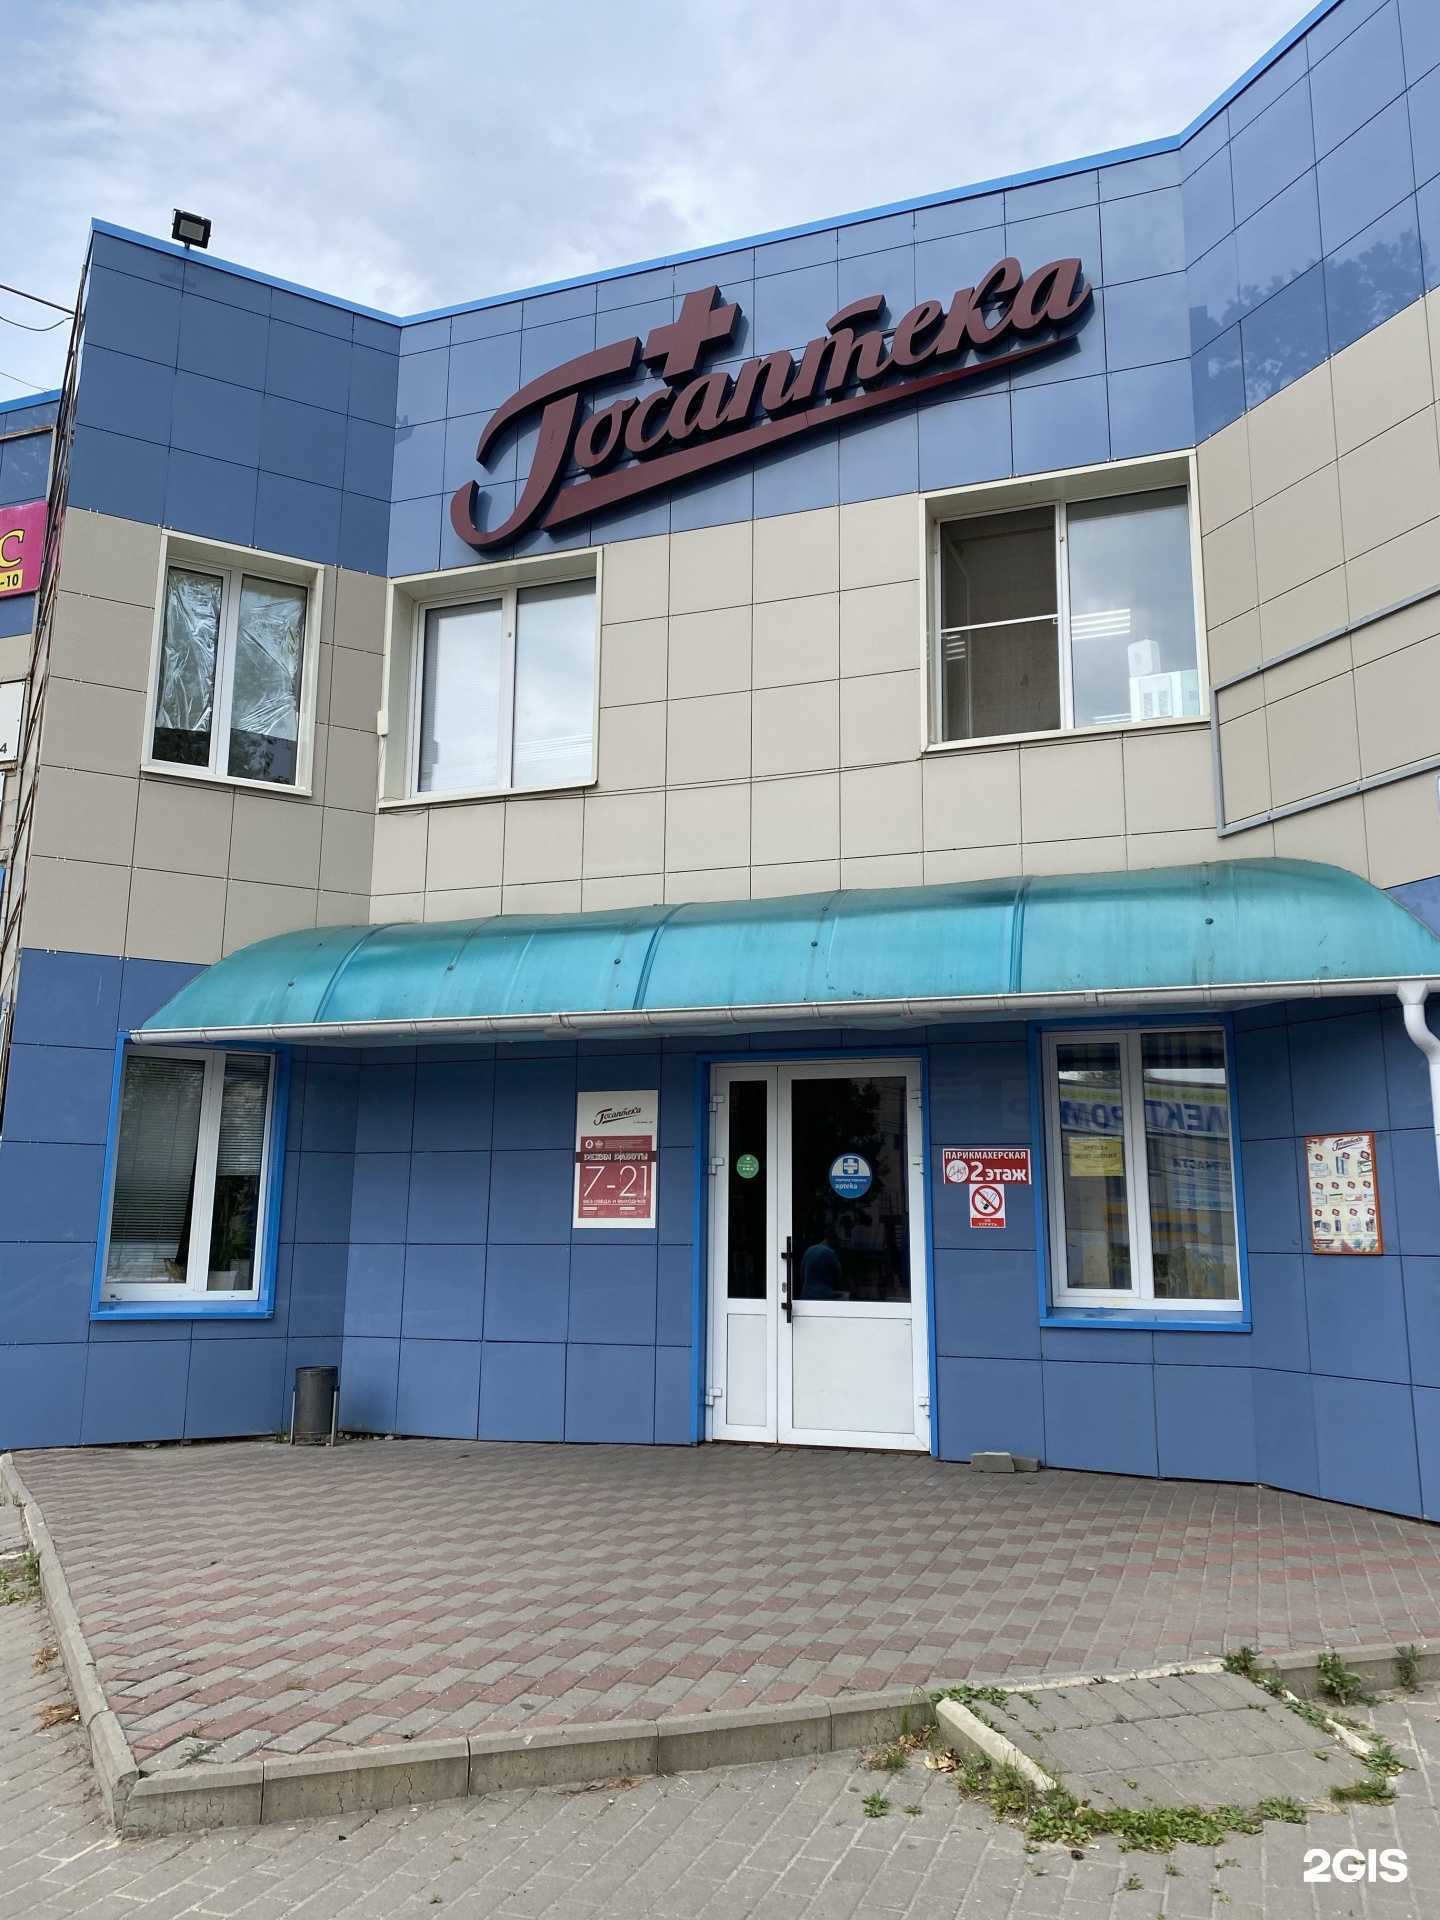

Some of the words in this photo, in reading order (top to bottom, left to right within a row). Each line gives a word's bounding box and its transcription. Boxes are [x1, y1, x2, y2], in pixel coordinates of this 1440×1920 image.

[451, 257, 1092, 549] Госаптека
[945, 1151, 1026, 1160] ПАРИКМАХЕРСКАЯ
[970, 1161, 984, 1181] 2
[985, 1168, 1027, 1181] этаж
